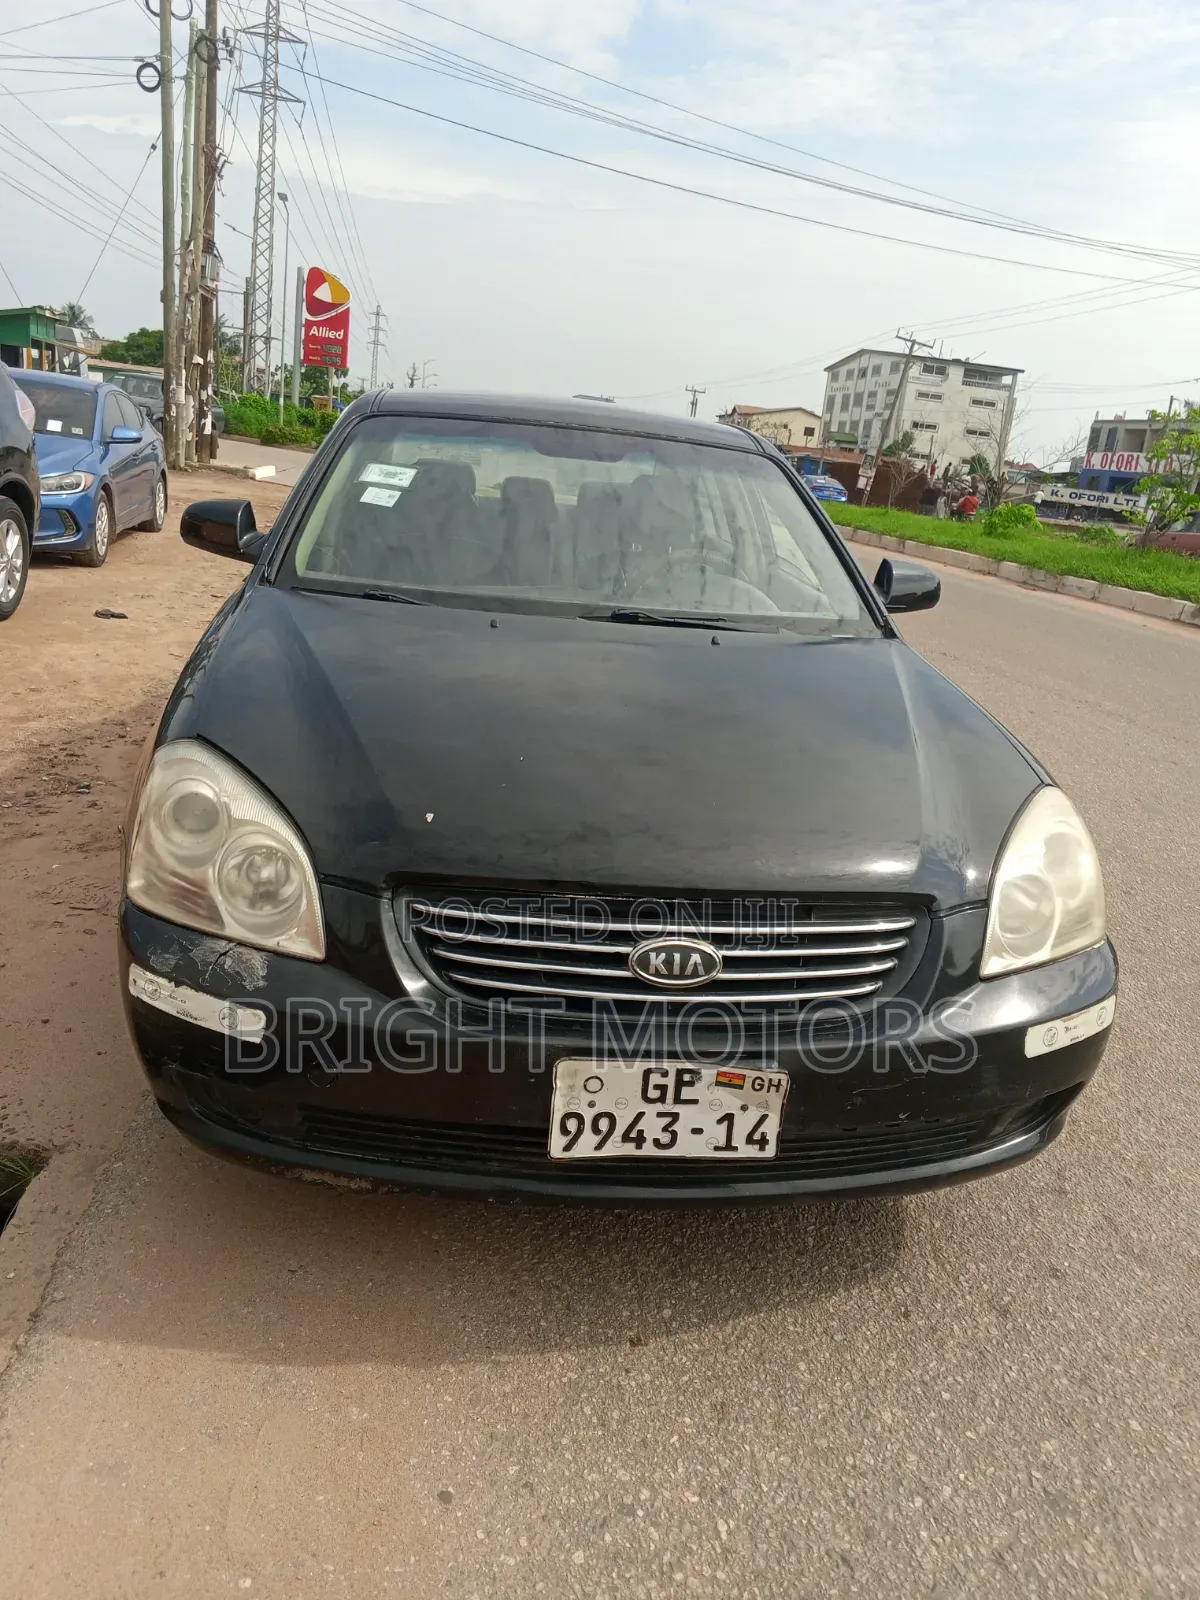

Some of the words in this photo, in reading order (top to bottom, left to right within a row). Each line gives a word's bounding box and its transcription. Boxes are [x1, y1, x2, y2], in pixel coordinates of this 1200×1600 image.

[309, 326, 344, 339] Allied
[1085, 452, 1095, 469] K.
[1100, 453, 1140, 471] OFORI
[1050, 489, 1064, 498] K.
[1069, 491, 1109, 504] OFORI
[649, 952, 705, 975] KIA
[641, 1067, 702, 1104] GE
[751, 1076, 781, 1093] GH
[559, 1111, 770, 1152] 9943-14
